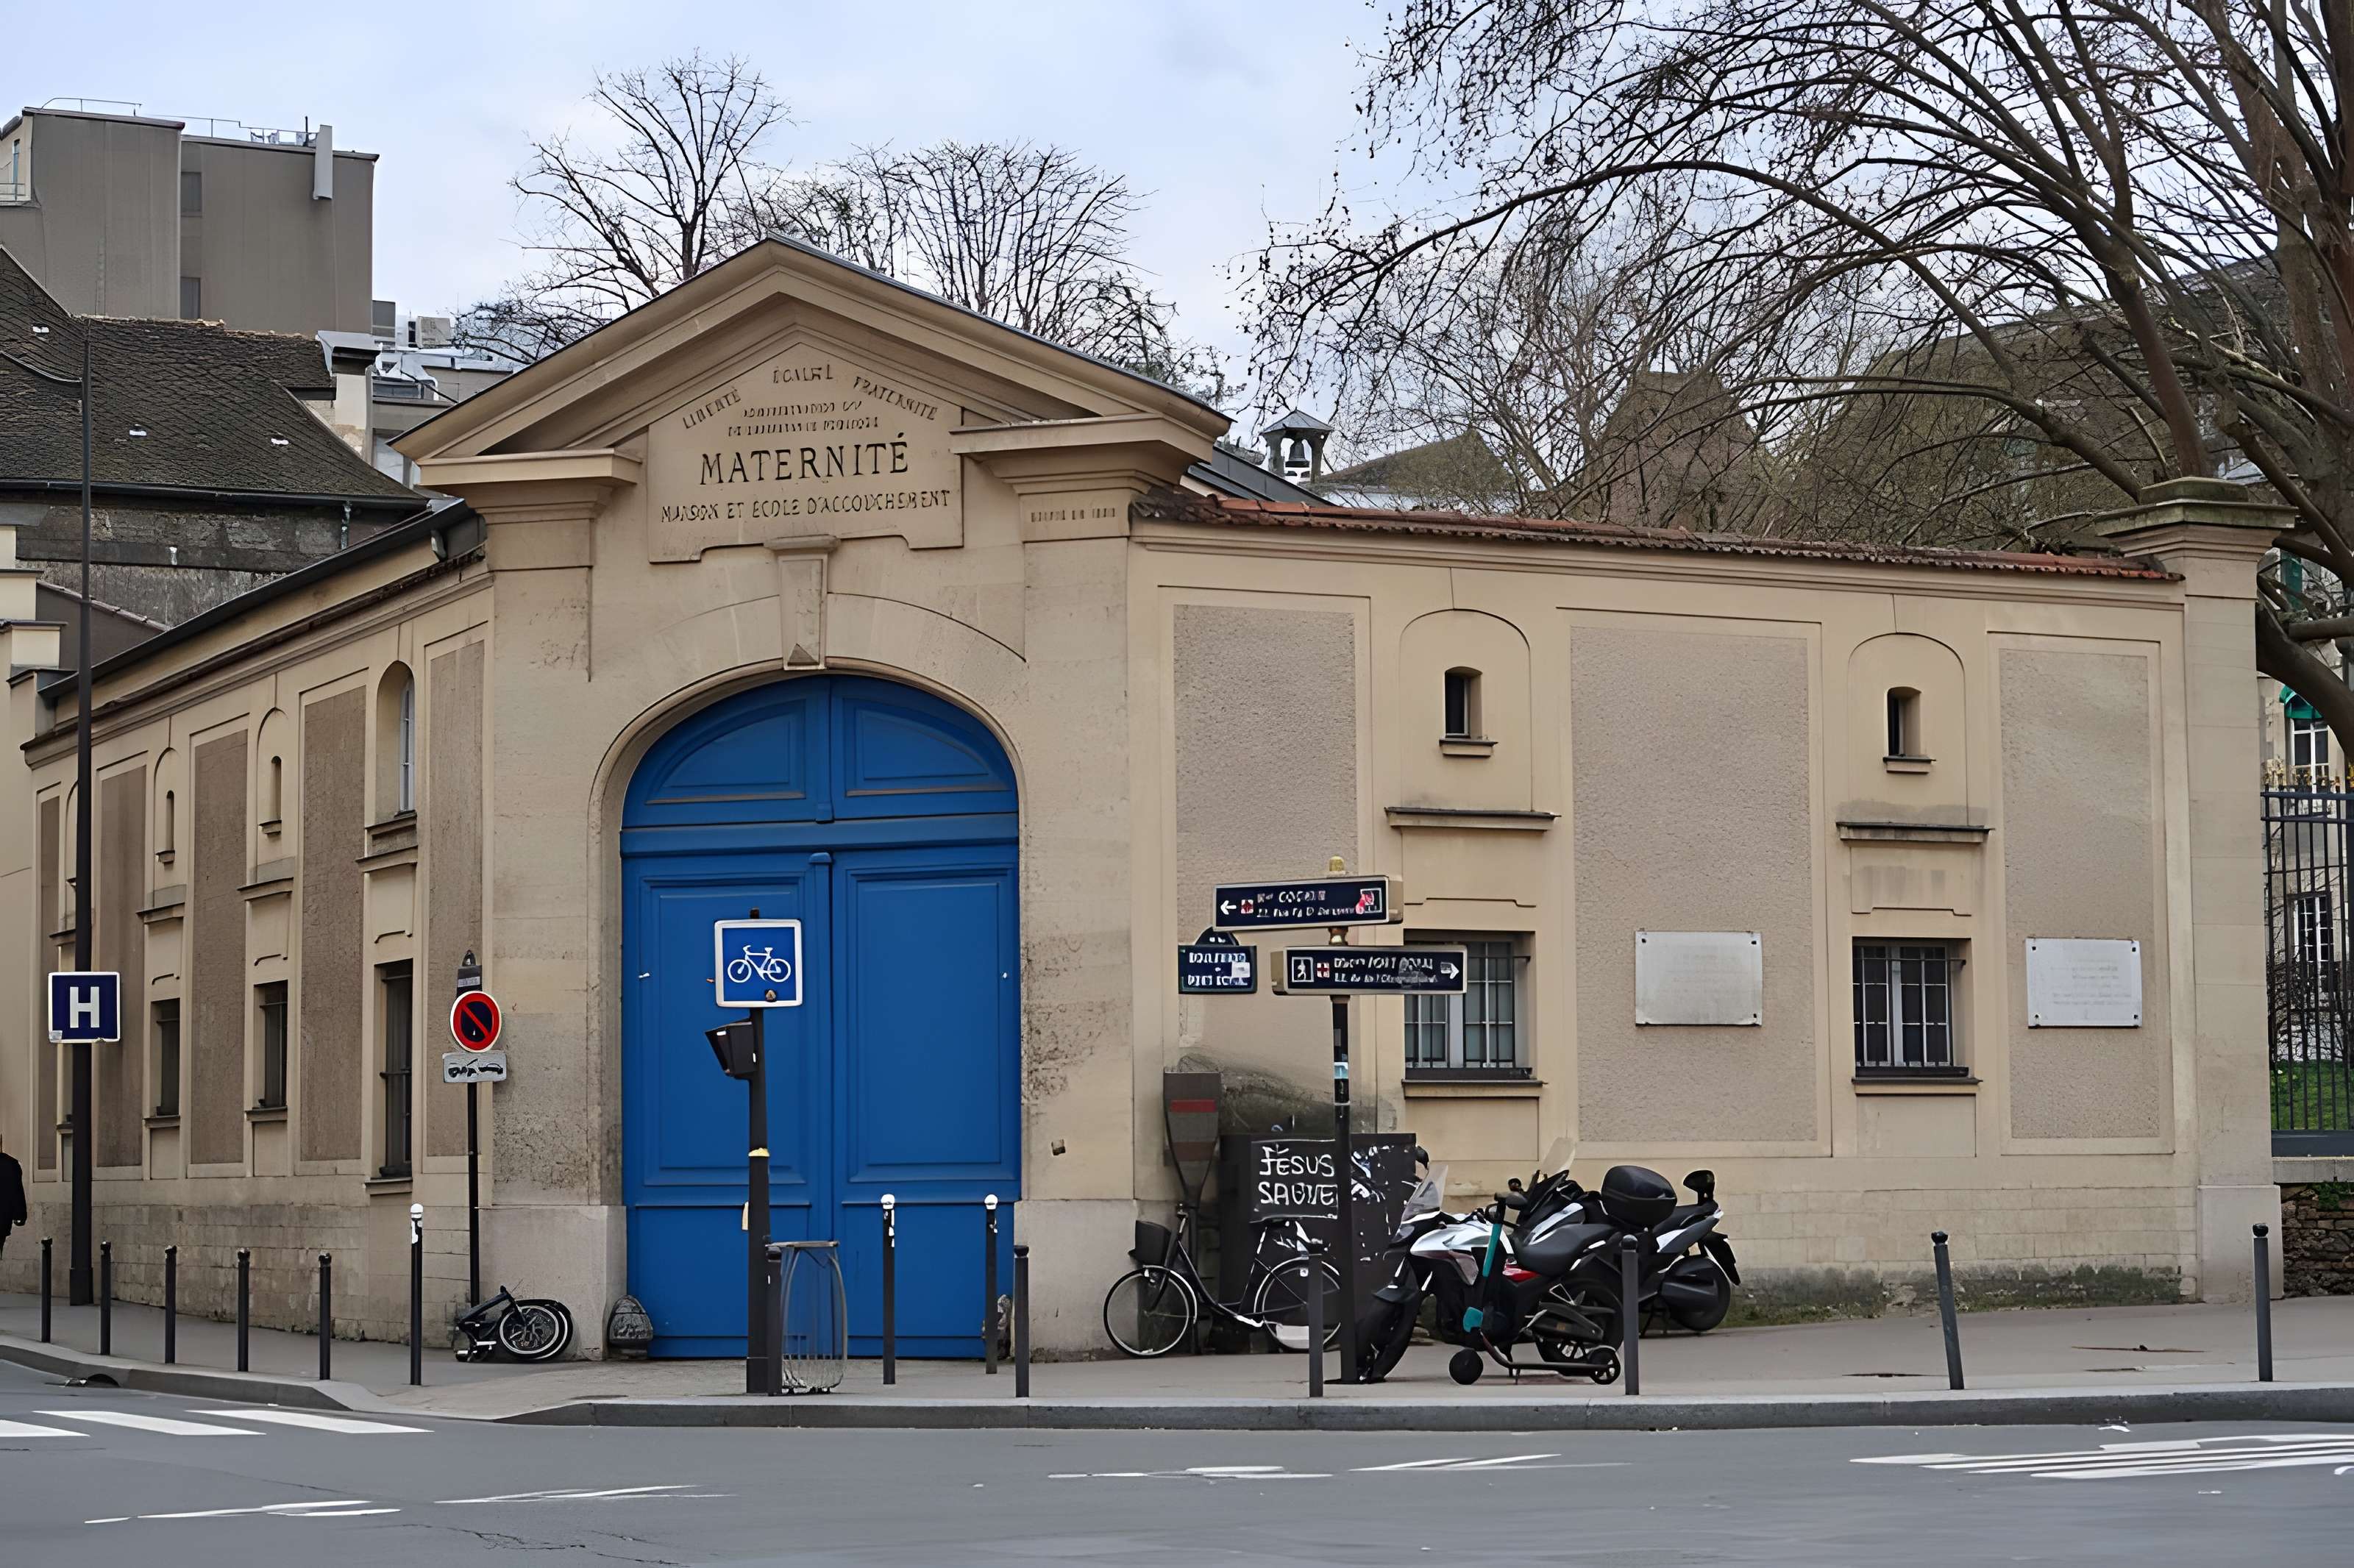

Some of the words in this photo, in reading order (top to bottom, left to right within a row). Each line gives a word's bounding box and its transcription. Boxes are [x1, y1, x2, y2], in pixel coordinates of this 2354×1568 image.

[699, 432, 909, 485] MATERNITÉ
[727, 502, 744, 519] ET
[69, 986, 100, 1028] H
